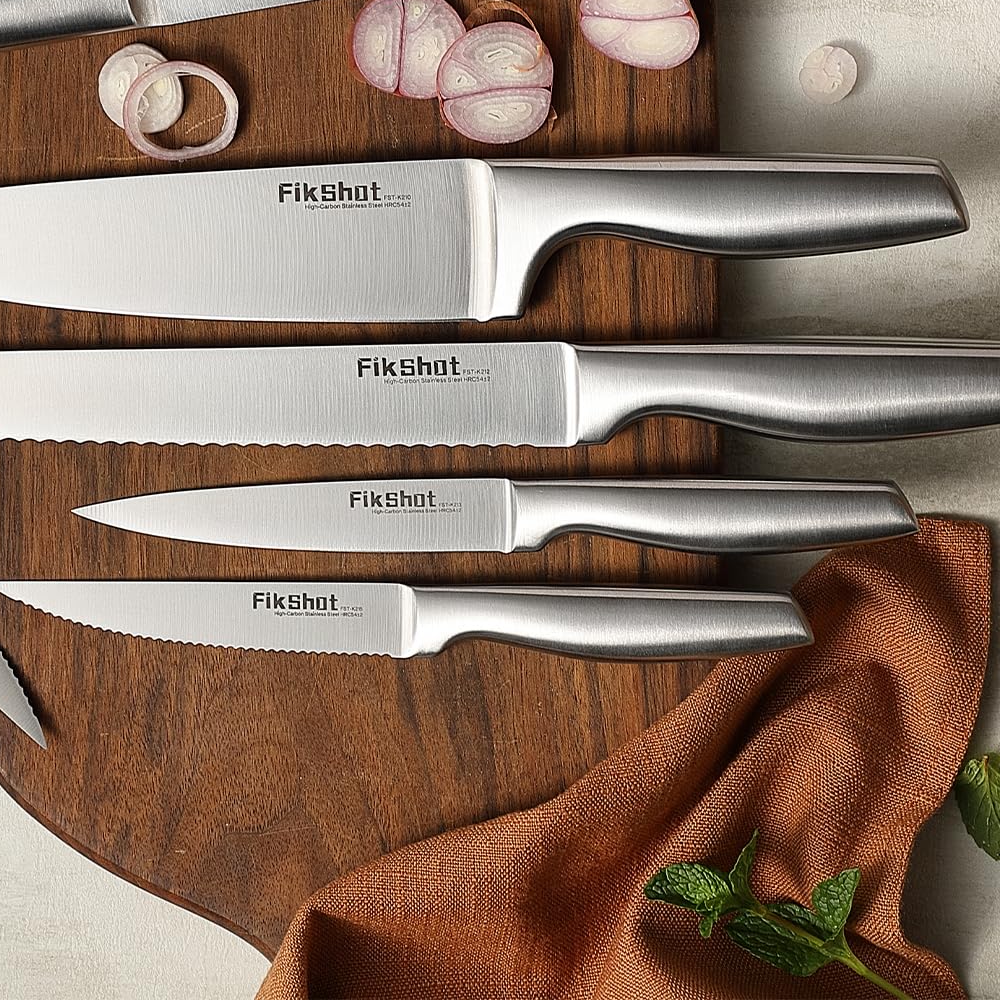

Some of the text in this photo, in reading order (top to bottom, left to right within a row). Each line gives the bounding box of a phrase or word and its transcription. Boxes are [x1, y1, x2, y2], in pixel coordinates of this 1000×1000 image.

[278, 180, 381, 203] FikShot
[357, 355, 460, 377] FikShot
[349, 489, 436, 508] FikShot
[252, 591, 338, 610] FikShot
